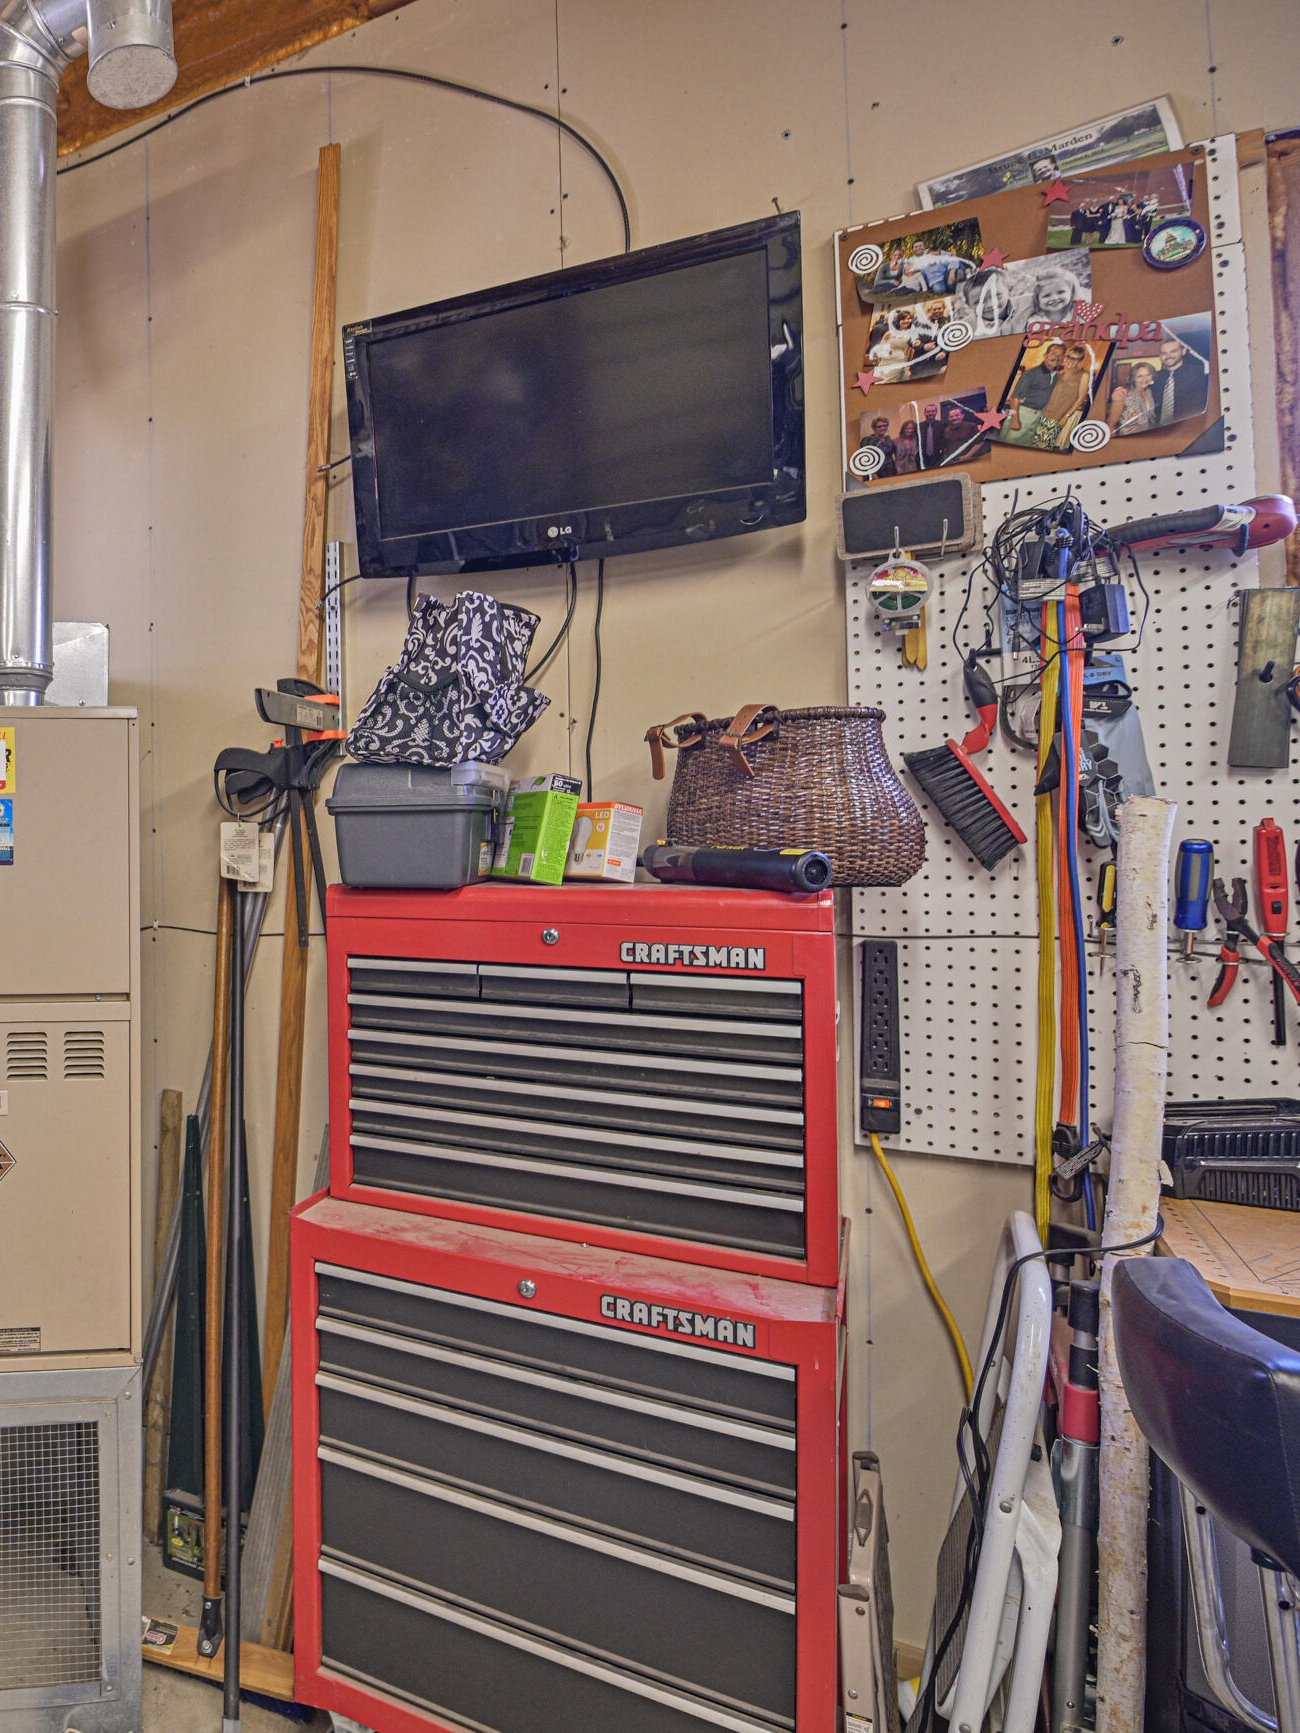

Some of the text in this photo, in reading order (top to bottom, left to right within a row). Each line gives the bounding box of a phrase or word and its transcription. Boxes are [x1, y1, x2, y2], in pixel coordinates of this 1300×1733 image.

[1044, 133, 1093, 154] Marden
[1023, 312, 1163, 349] grandpa
[560, 526, 572, 535] LG
[595, 811, 610, 819] LED
[620, 941, 766, 971] CRAFTSMAN
[600, 1293, 756, 1349] CRAFTSMAN
